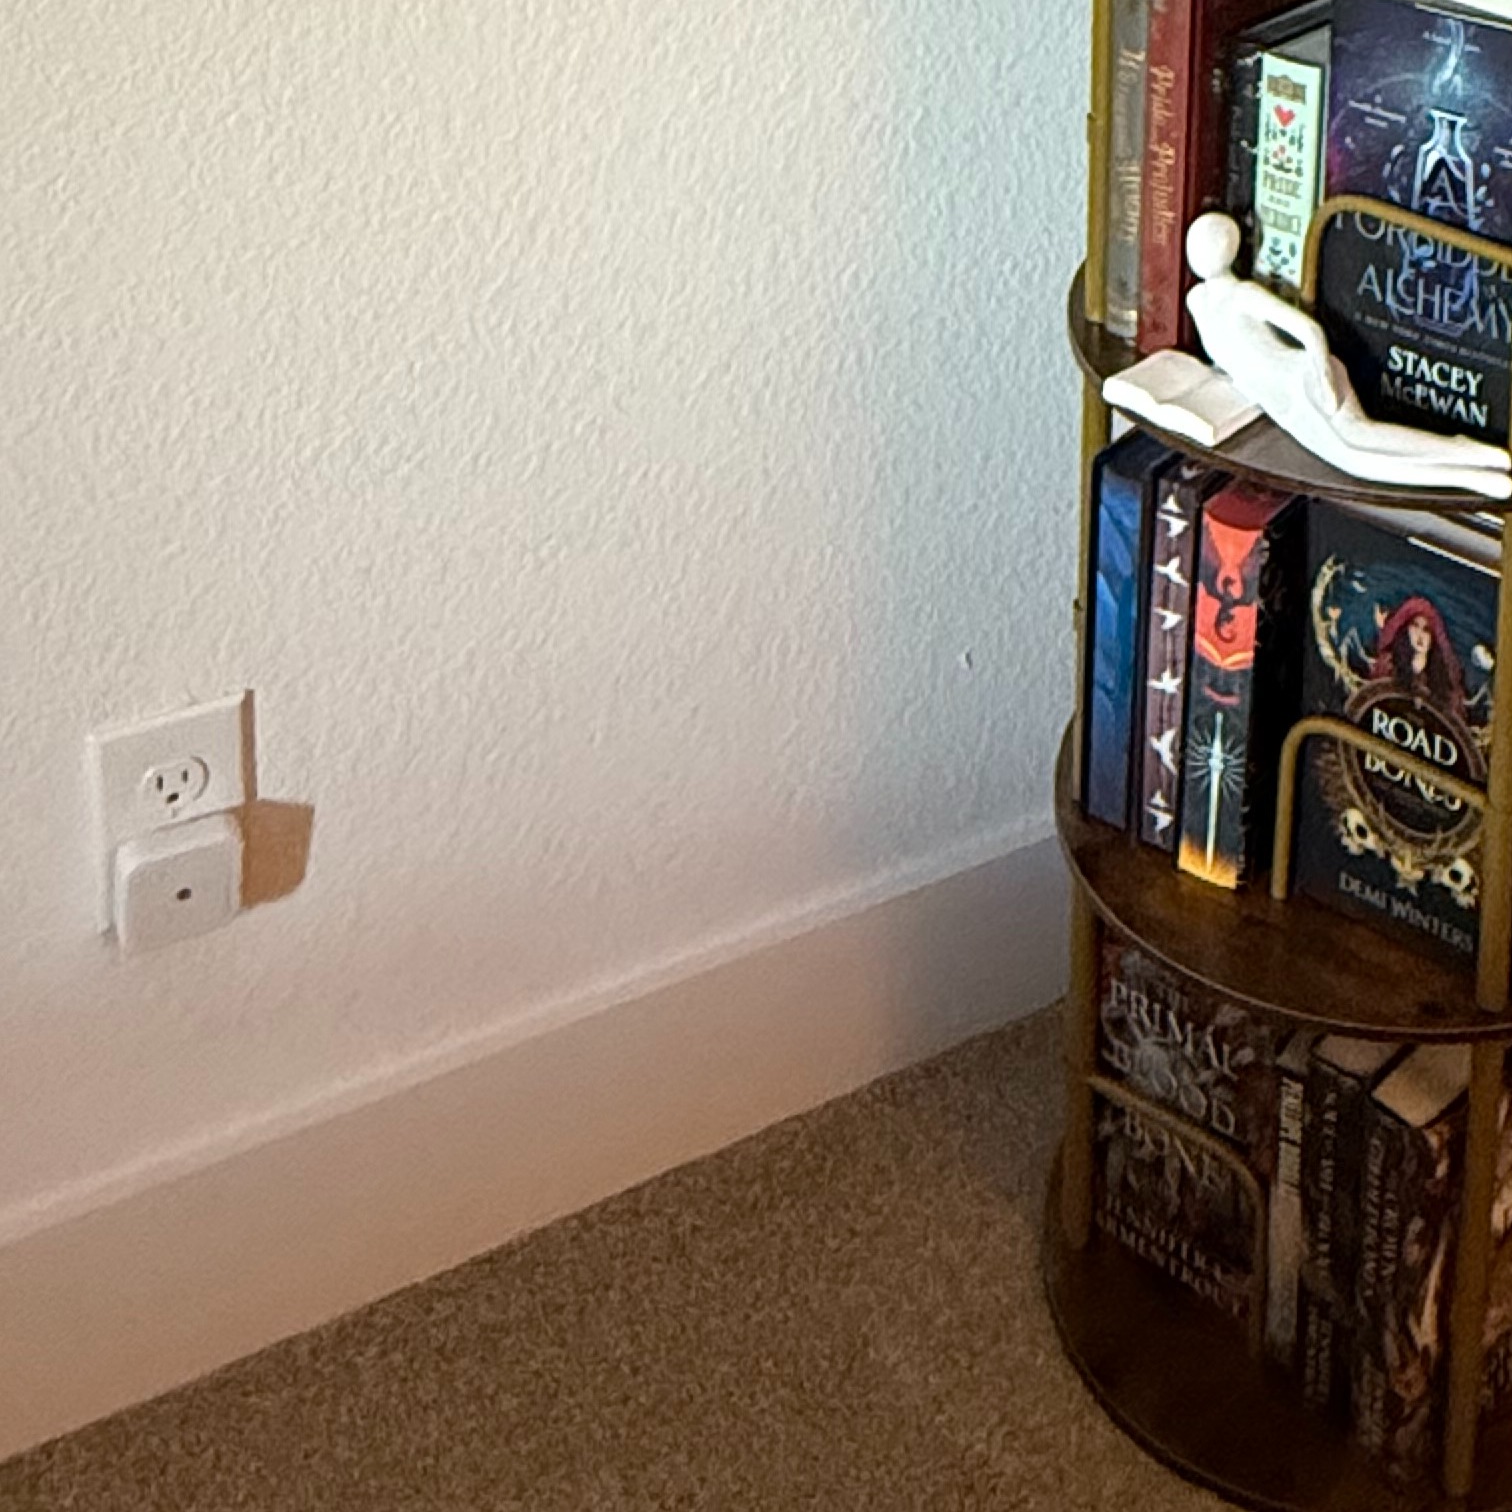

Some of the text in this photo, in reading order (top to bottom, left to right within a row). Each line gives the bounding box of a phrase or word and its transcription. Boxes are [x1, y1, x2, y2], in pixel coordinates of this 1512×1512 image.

[1387, 345, 1483, 397] STACEY
[1380, 372, 1489, 428] McEWAN
[1372, 707, 1458, 766] ROAD
[1338, 871, 1473, 954] DEMI WINTERS
